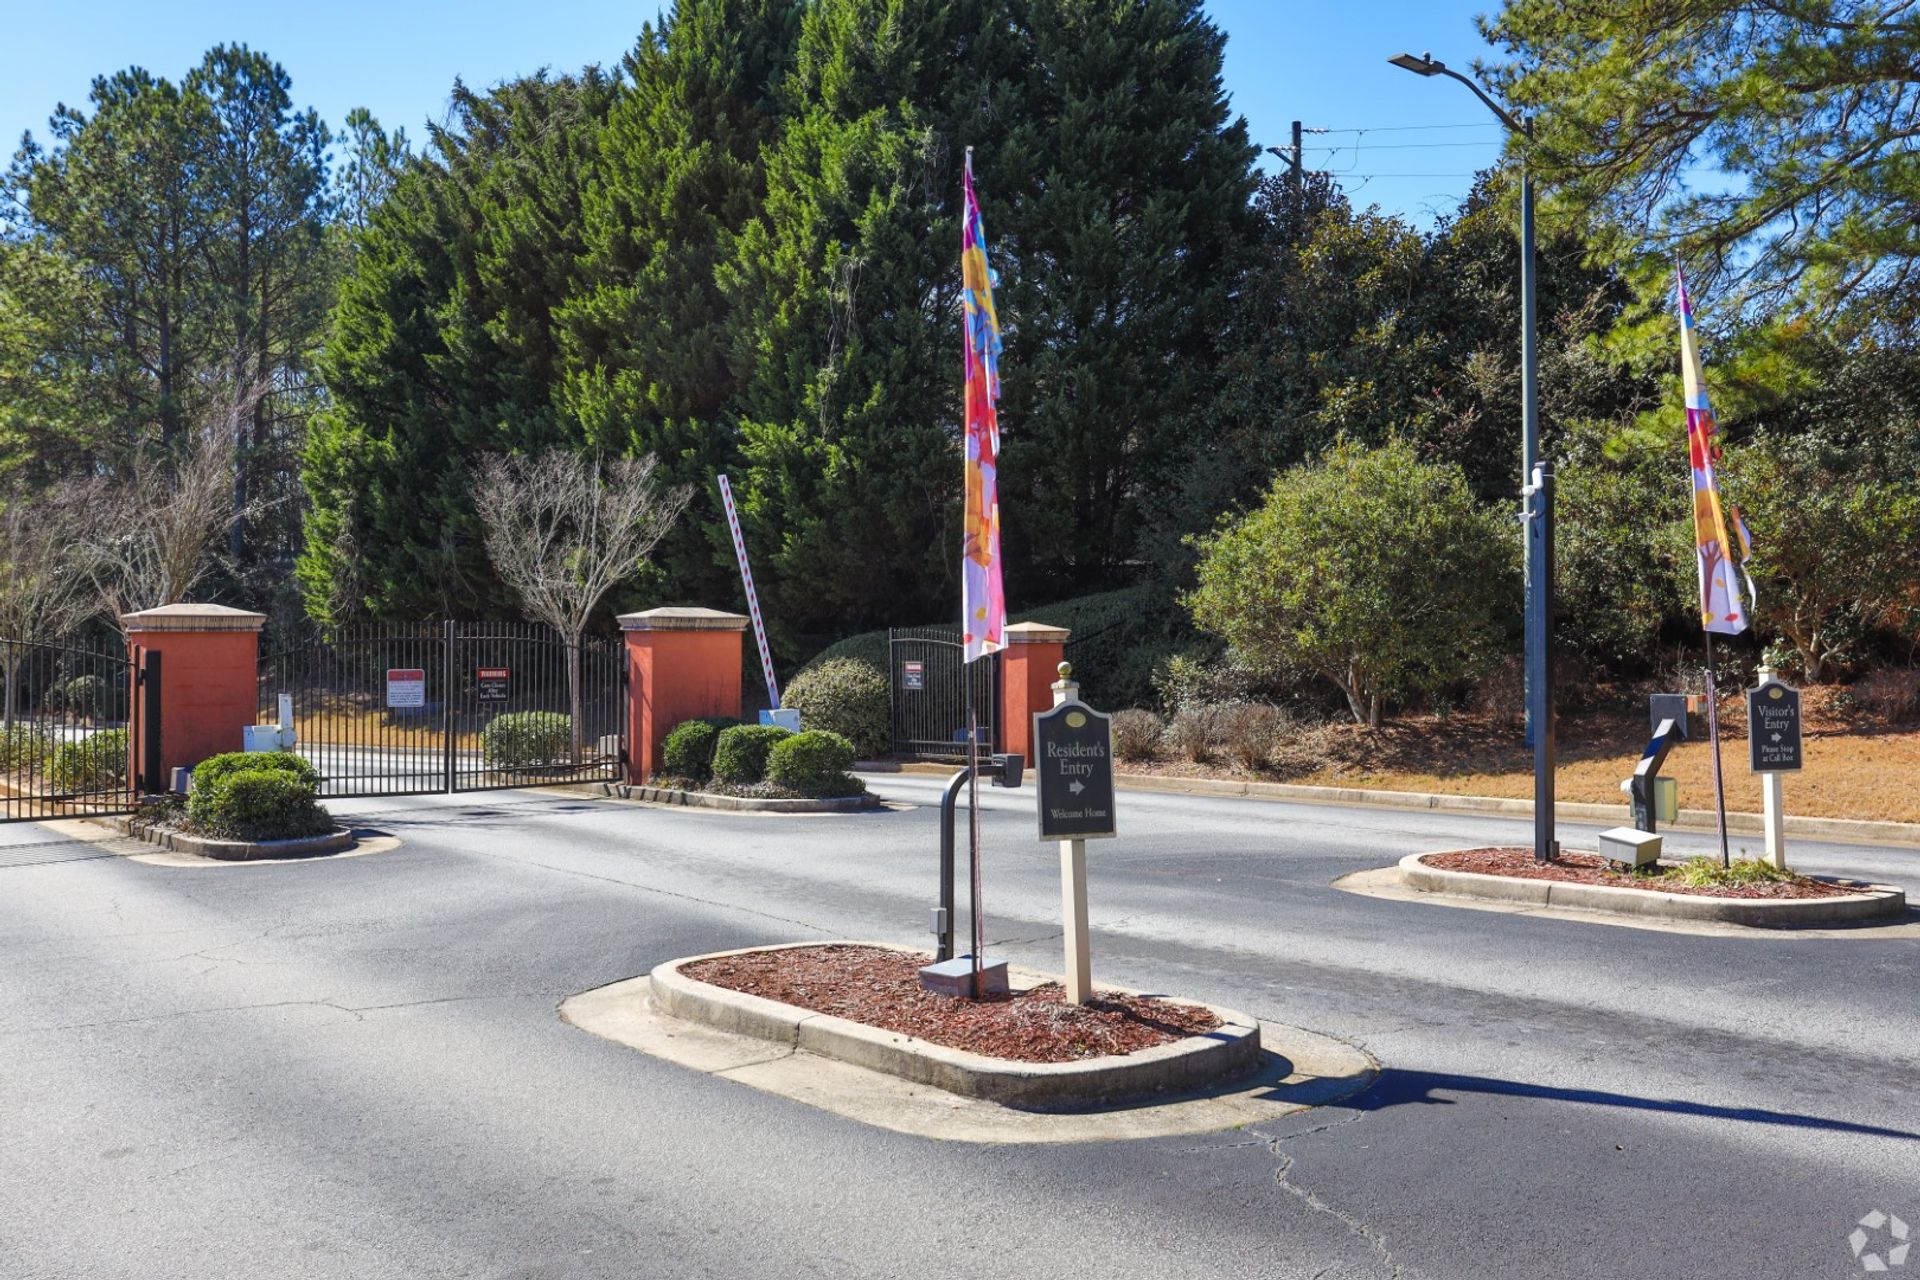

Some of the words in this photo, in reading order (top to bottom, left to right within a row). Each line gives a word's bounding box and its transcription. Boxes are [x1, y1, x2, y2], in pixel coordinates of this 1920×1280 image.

[1757, 704, 1795, 717] Visitor's
[1764, 717, 1790, 731] Entry
[1047, 741, 1105, 758] Resident's
[1761, 744, 1779, 753] Please
[1780, 744, 1794, 753] Stop
[1060, 758, 1094, 778] Entry
[1050, 808, 1083, 819] Welcome
[1084, 807, 1106, 818] Home
